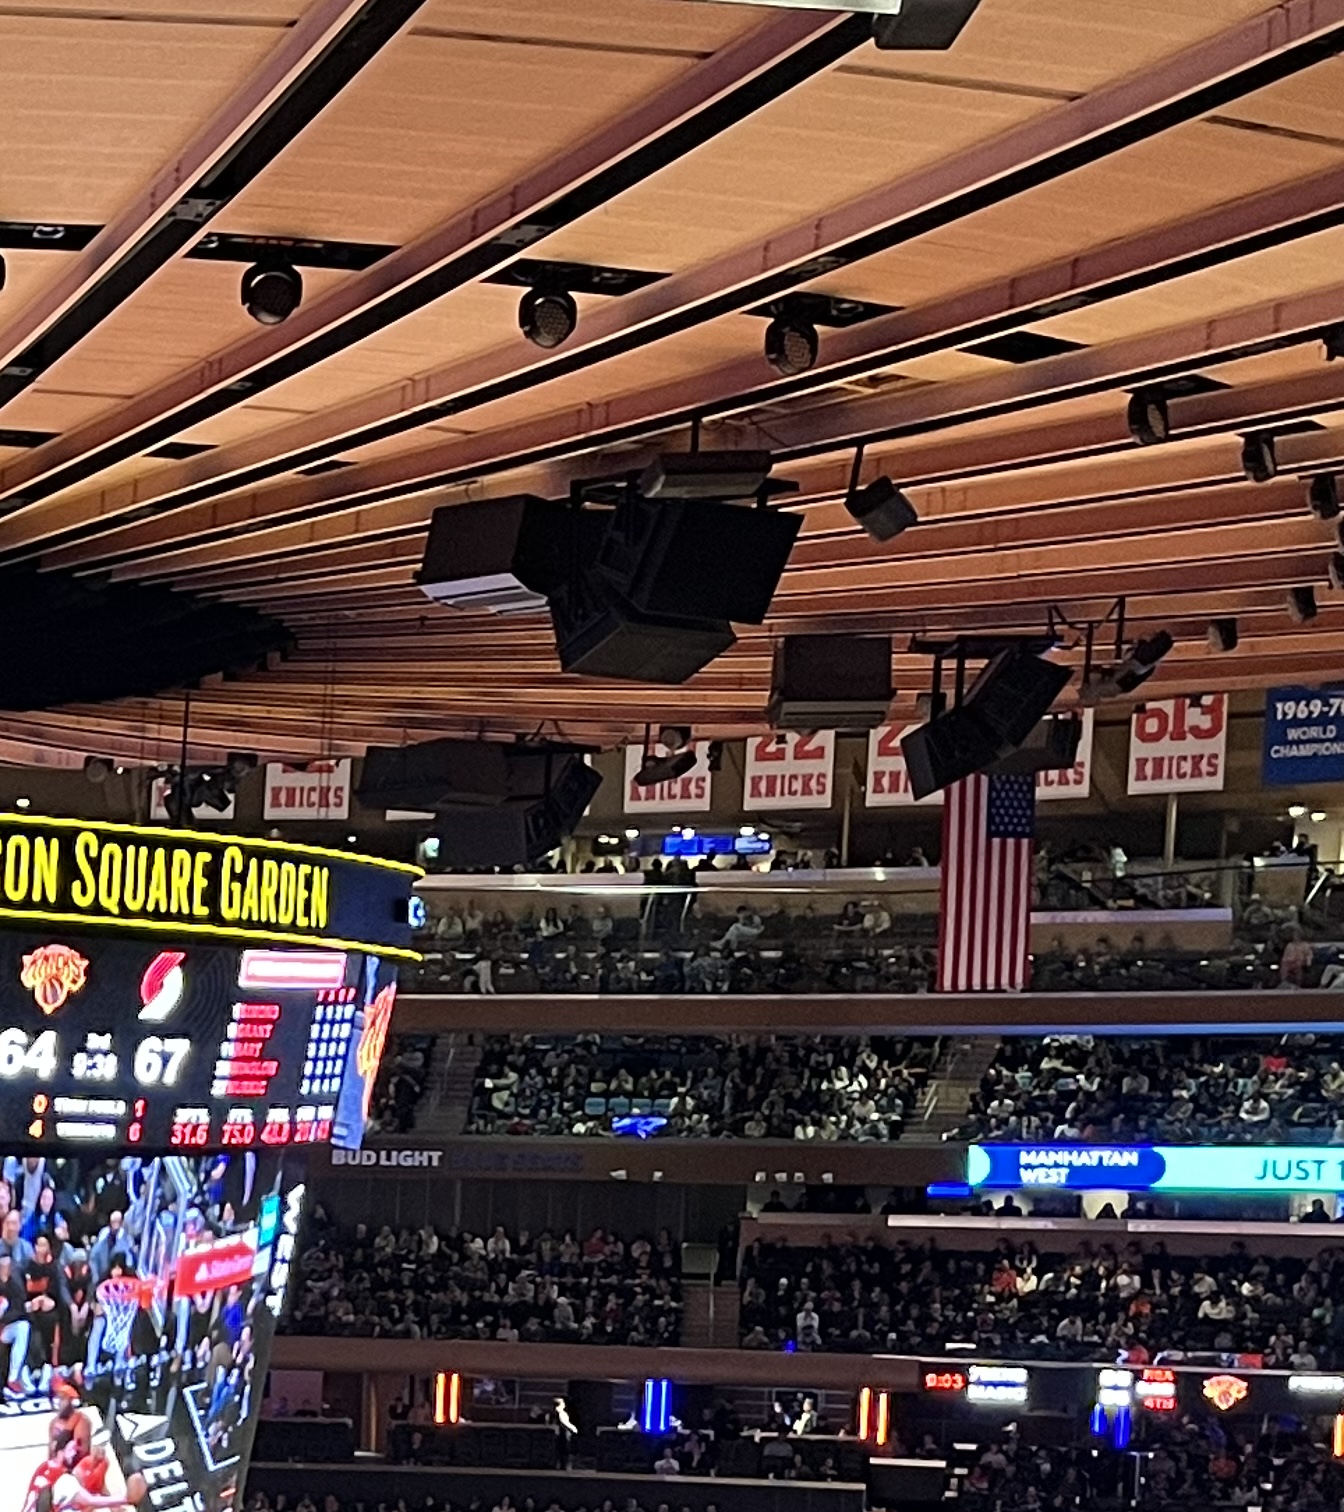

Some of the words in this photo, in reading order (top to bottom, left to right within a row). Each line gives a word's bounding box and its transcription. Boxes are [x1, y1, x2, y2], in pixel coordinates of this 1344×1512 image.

[1276, 697, 1344, 720] 1969-7
[1287, 725, 1337, 741] WORLD
[1134, 753, 1219, 782] KNICKS
[749, 772, 827, 798] KNICKS
[269, 785, 344, 809] KNICKS
[71, 830, 212, 916] SQUARE
[220, 845, 331, 930] GARDEN
[133, 1035, 191, 1087] 67
[331, 1149, 379, 1167] BUD
[380, 1150, 443, 1167] LIGHT
[1018, 1150, 1139, 1167] MANHATTAN
[1018, 1167, 1070, 1184] WEST
[1255, 1159, 1328, 1182] JUST
